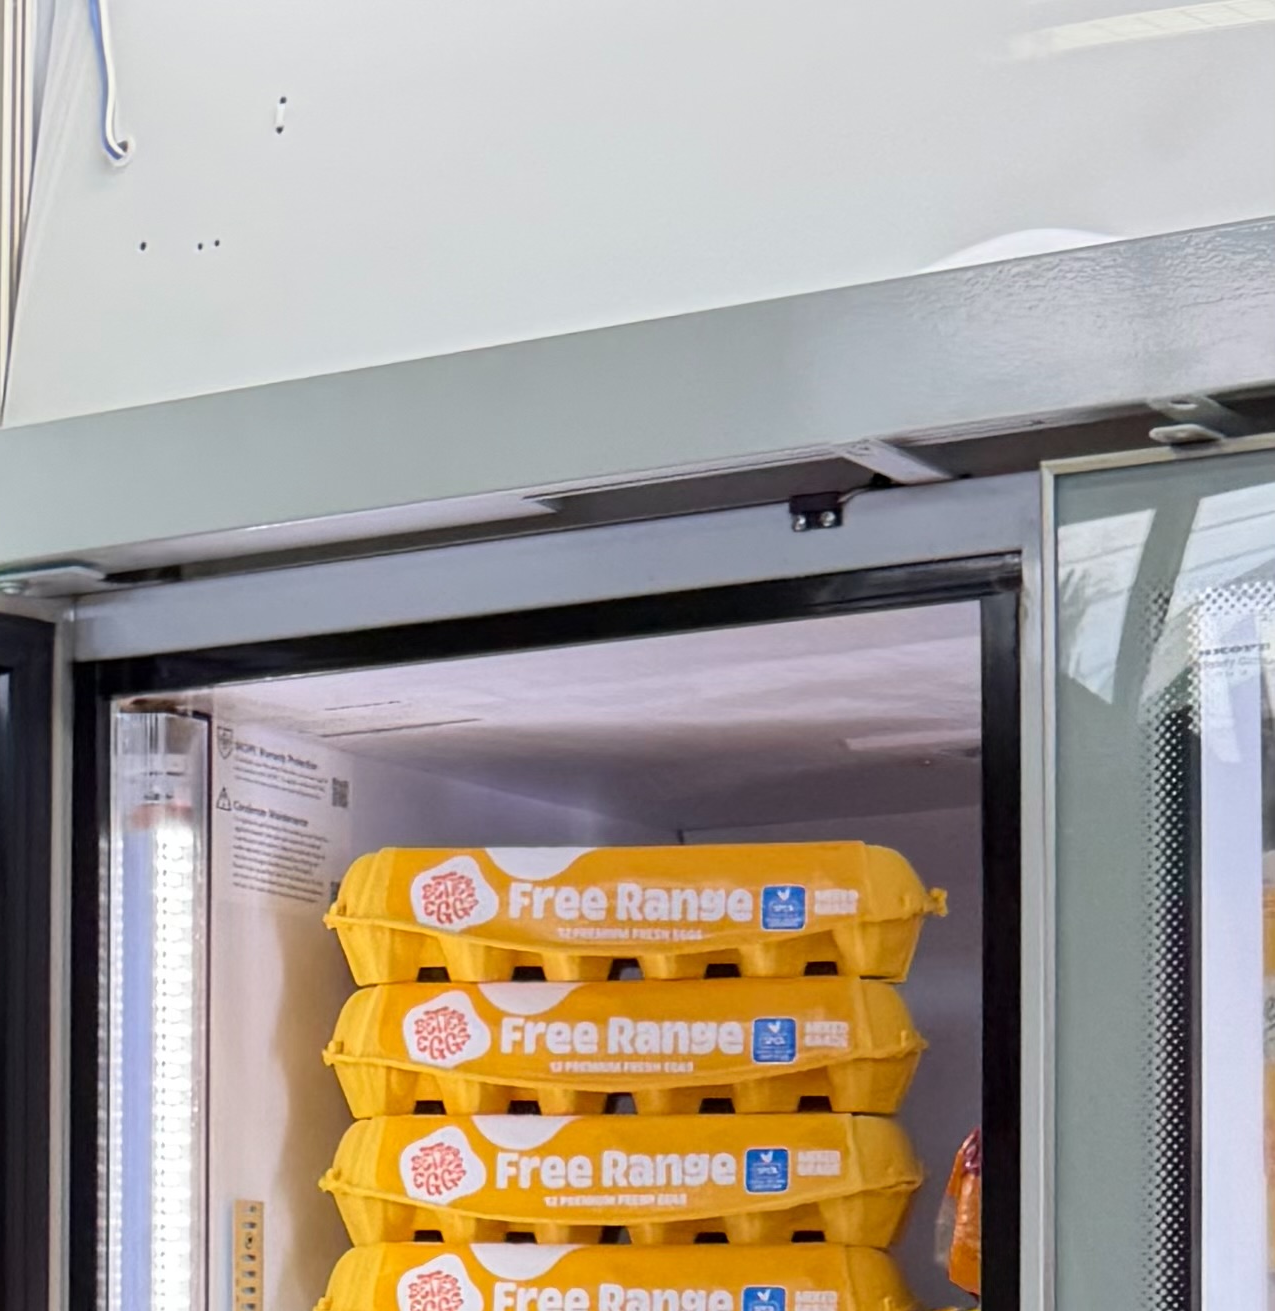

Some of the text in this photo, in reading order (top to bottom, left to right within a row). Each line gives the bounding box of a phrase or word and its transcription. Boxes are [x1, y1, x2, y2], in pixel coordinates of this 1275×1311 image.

[508, 882, 753, 921] Free Range
[500, 1016, 744, 1054] Free Range
[496, 1150, 736, 1189] Free Range
